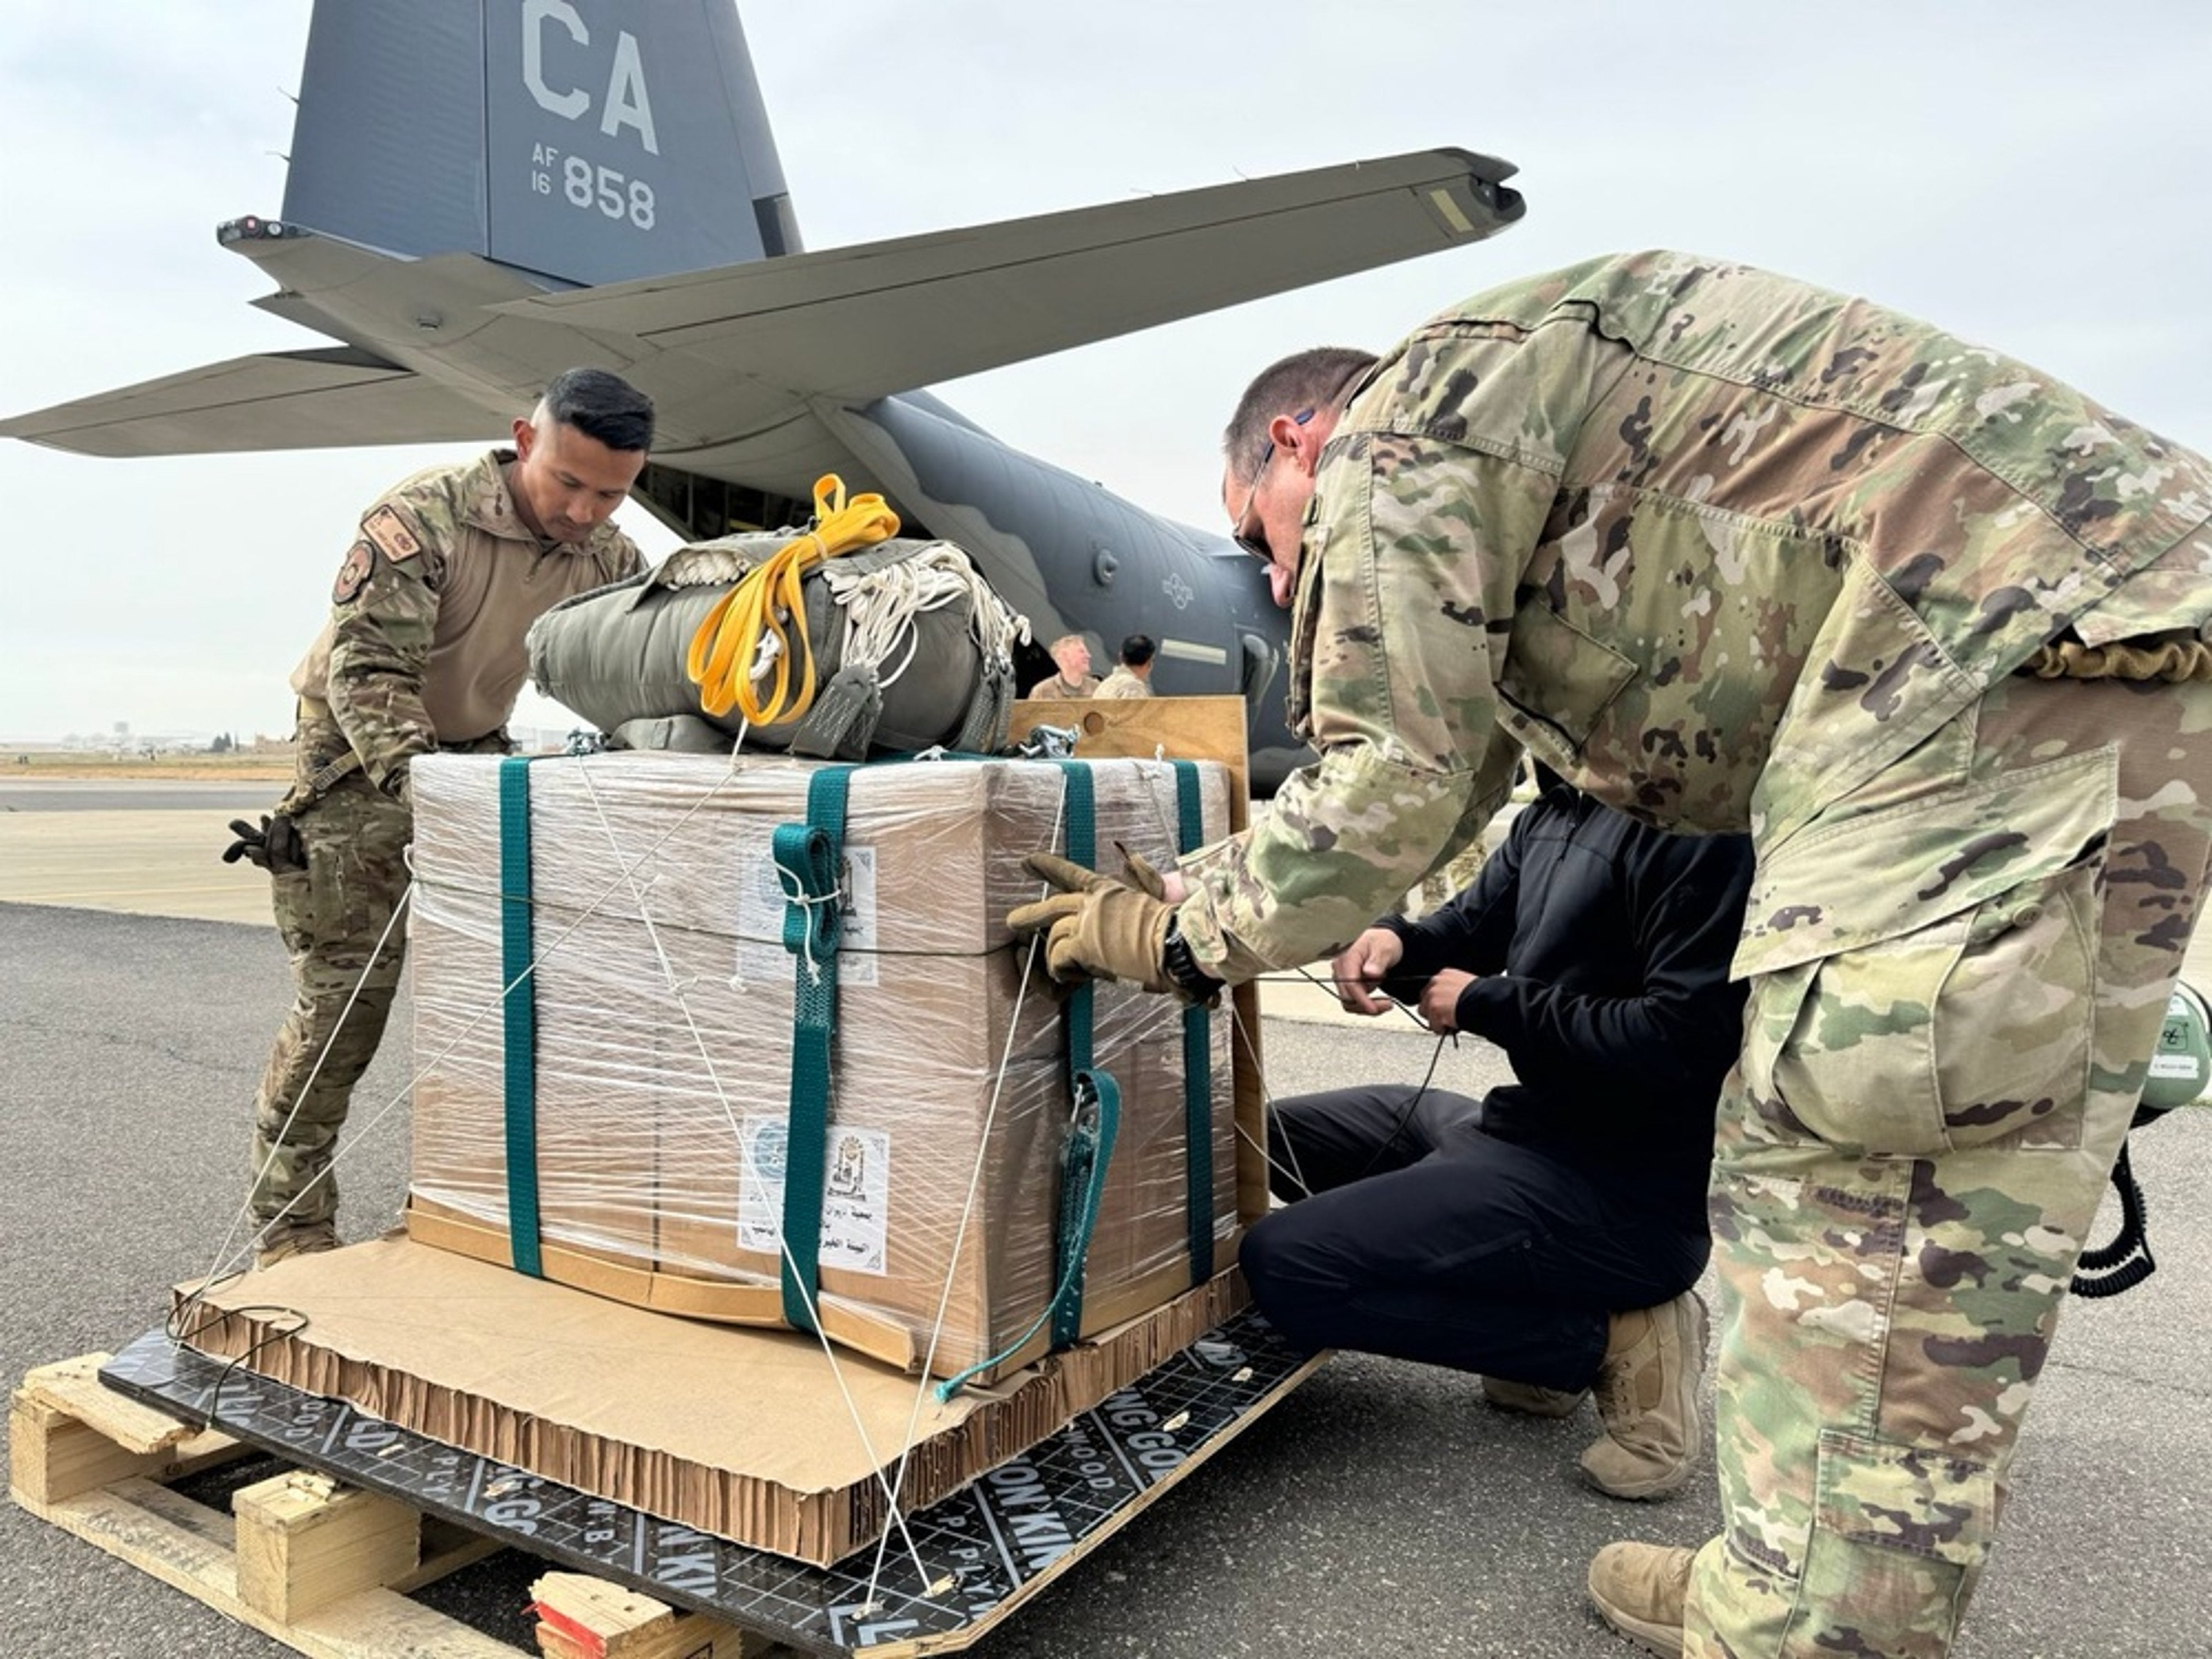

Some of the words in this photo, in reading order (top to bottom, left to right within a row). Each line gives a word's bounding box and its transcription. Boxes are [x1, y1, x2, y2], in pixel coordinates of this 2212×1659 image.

[522, 0, 658, 156] CA
[532, 142, 559, 166] AF
[532, 170, 552, 196] 16
[564, 156, 656, 231] 858
